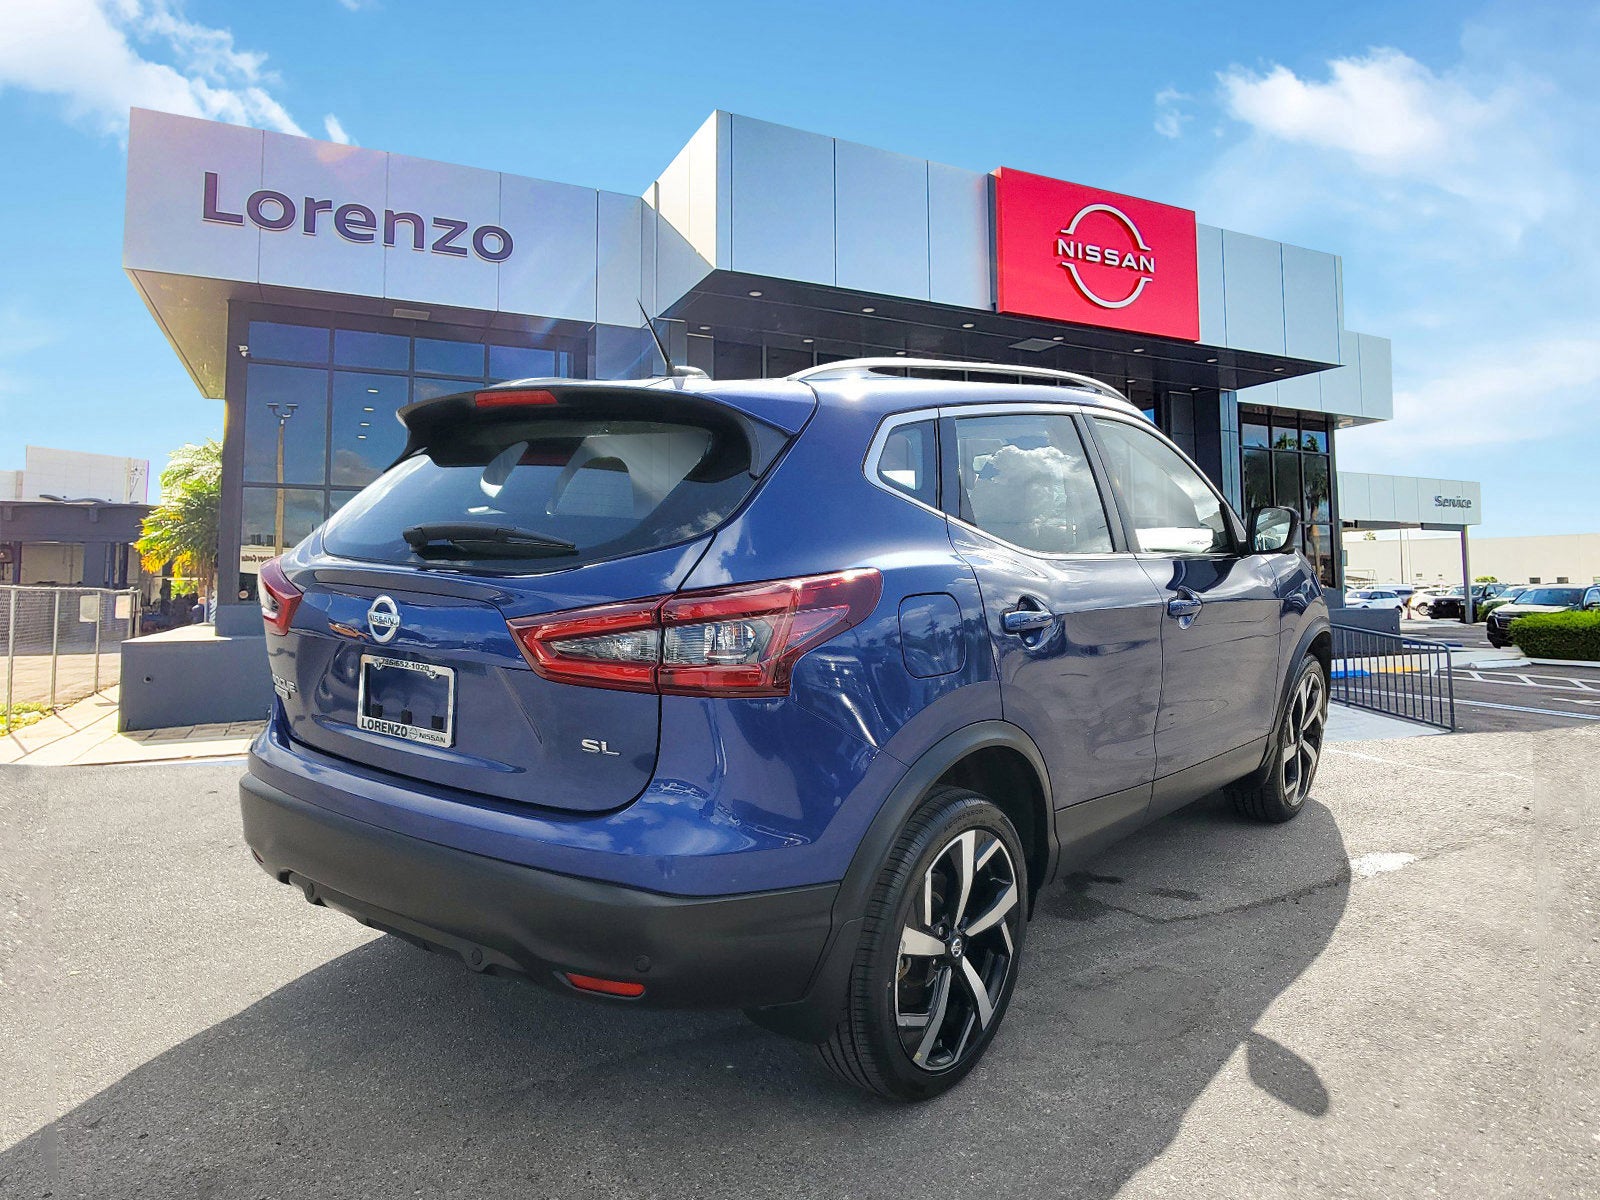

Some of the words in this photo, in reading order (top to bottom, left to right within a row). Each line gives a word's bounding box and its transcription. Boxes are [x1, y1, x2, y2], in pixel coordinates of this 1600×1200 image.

[202, 171, 515, 263] Lorenzo
[1057, 238, 1155, 273] NISSAN
[1434, 495, 1472, 509] Service
[369, 612, 396, 626] NISSAN
[361, 717, 408, 738] LORENZO
[418, 732, 446, 744] NISSAN
[581, 739, 621, 756] SL
